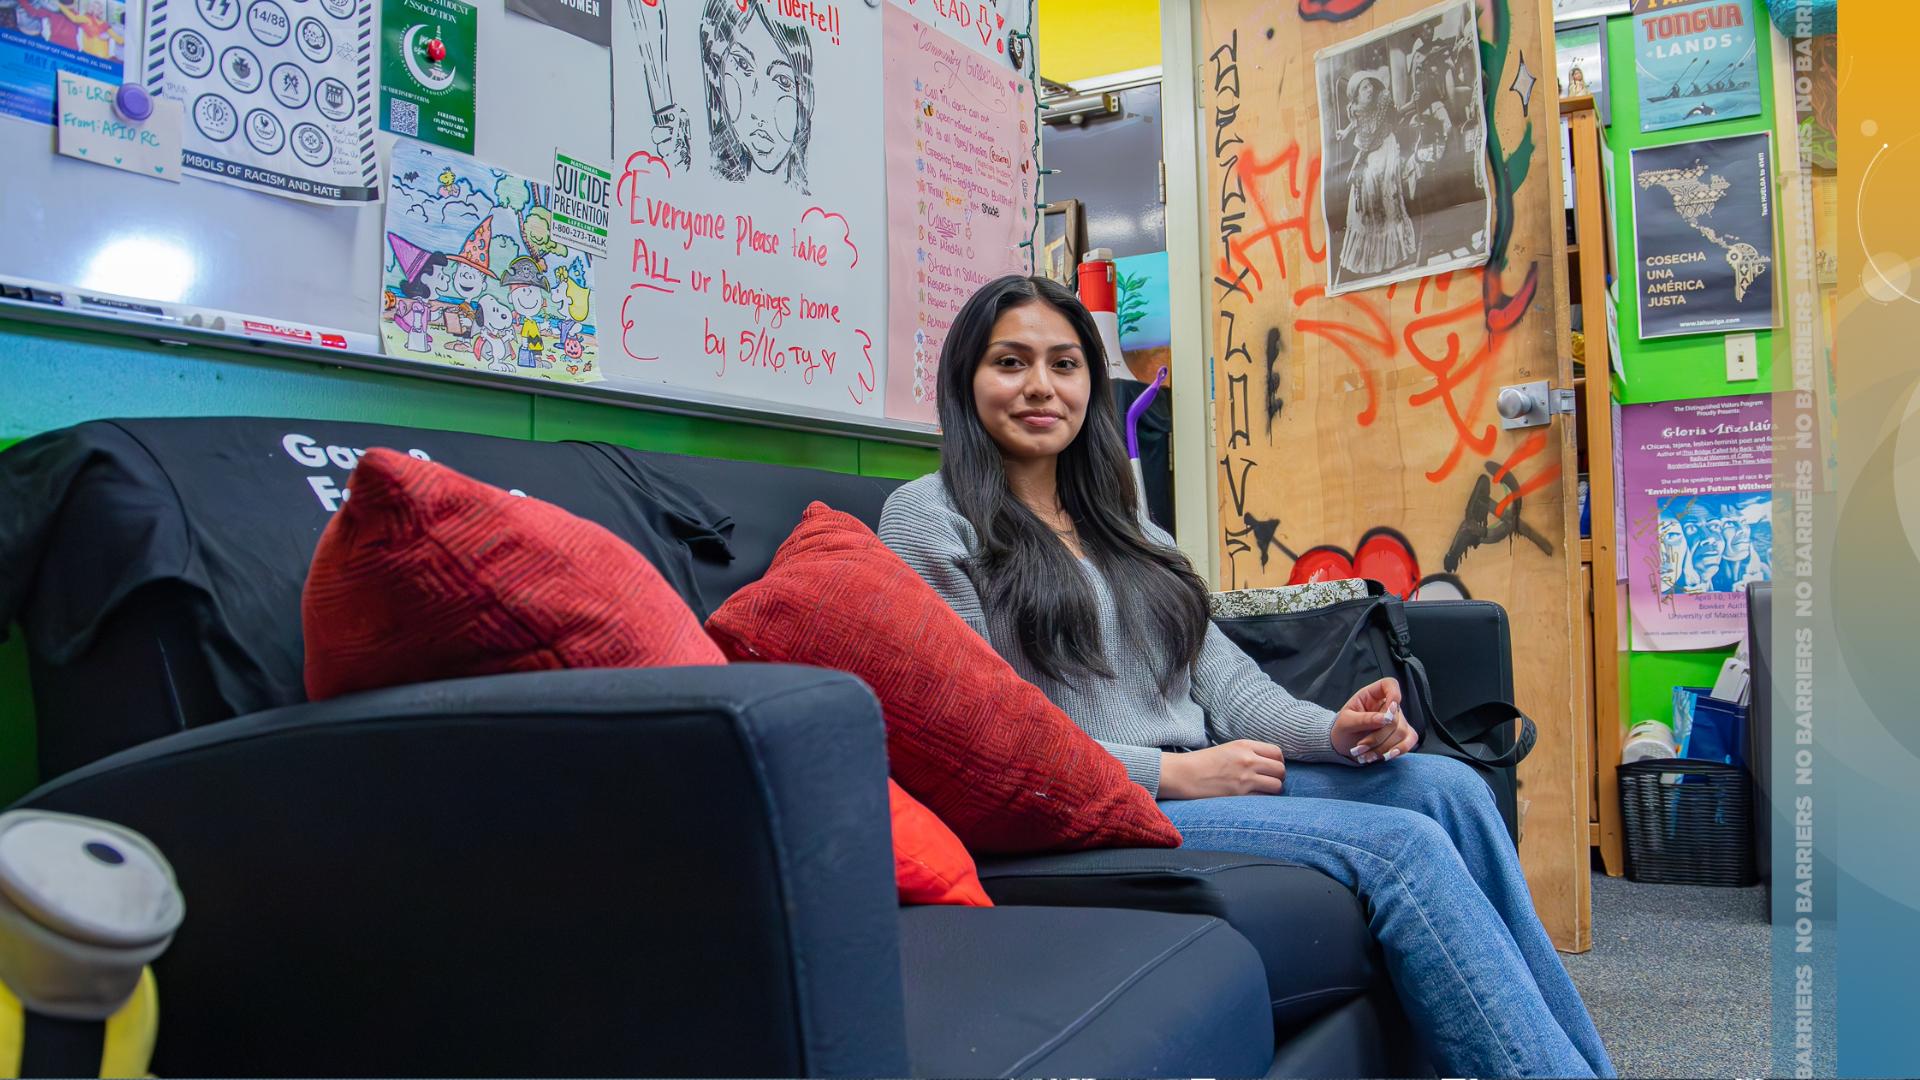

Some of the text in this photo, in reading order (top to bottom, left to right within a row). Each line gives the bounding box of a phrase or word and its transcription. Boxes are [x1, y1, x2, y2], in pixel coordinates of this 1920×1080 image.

[253, 8, 285, 28] 14/88
[560, 0, 600, 17] WOMEN
[1642, 4, 1744, 42] TONGVA
[1656, 33, 1732, 59] LANDS
[62, 79, 113, 103] To: LRC
[64, 112, 100, 132] From:
[140, 130, 161, 147] RC
[181, 153, 341, 198] YMBOLS OF RACISM AND HATE
[571, 160, 598, 174] NATIONAL
[555, 164, 611, 208] SUICIDE
[554, 194, 608, 228] PREVENTION
[630, 170, 726, 249] Everyone
[736, 215, 780, 256] Please
[793, 228, 828, 267] take
[553, 222, 607, 247] 1-800-273-TALK
[928, 253, 952, 277] Stand
[1646, 251, 1707, 266] COSECHA
[632, 239, 681, 283] ALL
[722, 270, 791, 329] belongings
[800, 293, 840, 324] home
[1646, 269, 1674, 280] UNA
[1647, 280, 1705, 294] AMÉRICA
[1647, 295, 1687, 308] JUSTA
[704, 317, 726, 377] by
[1685, 403, 1721, 411] Distinguished
[1740, 400, 1763, 408] Program
[1663, 426, 1707, 438] Gloria
[1708, 484, 1736, 493] Future
